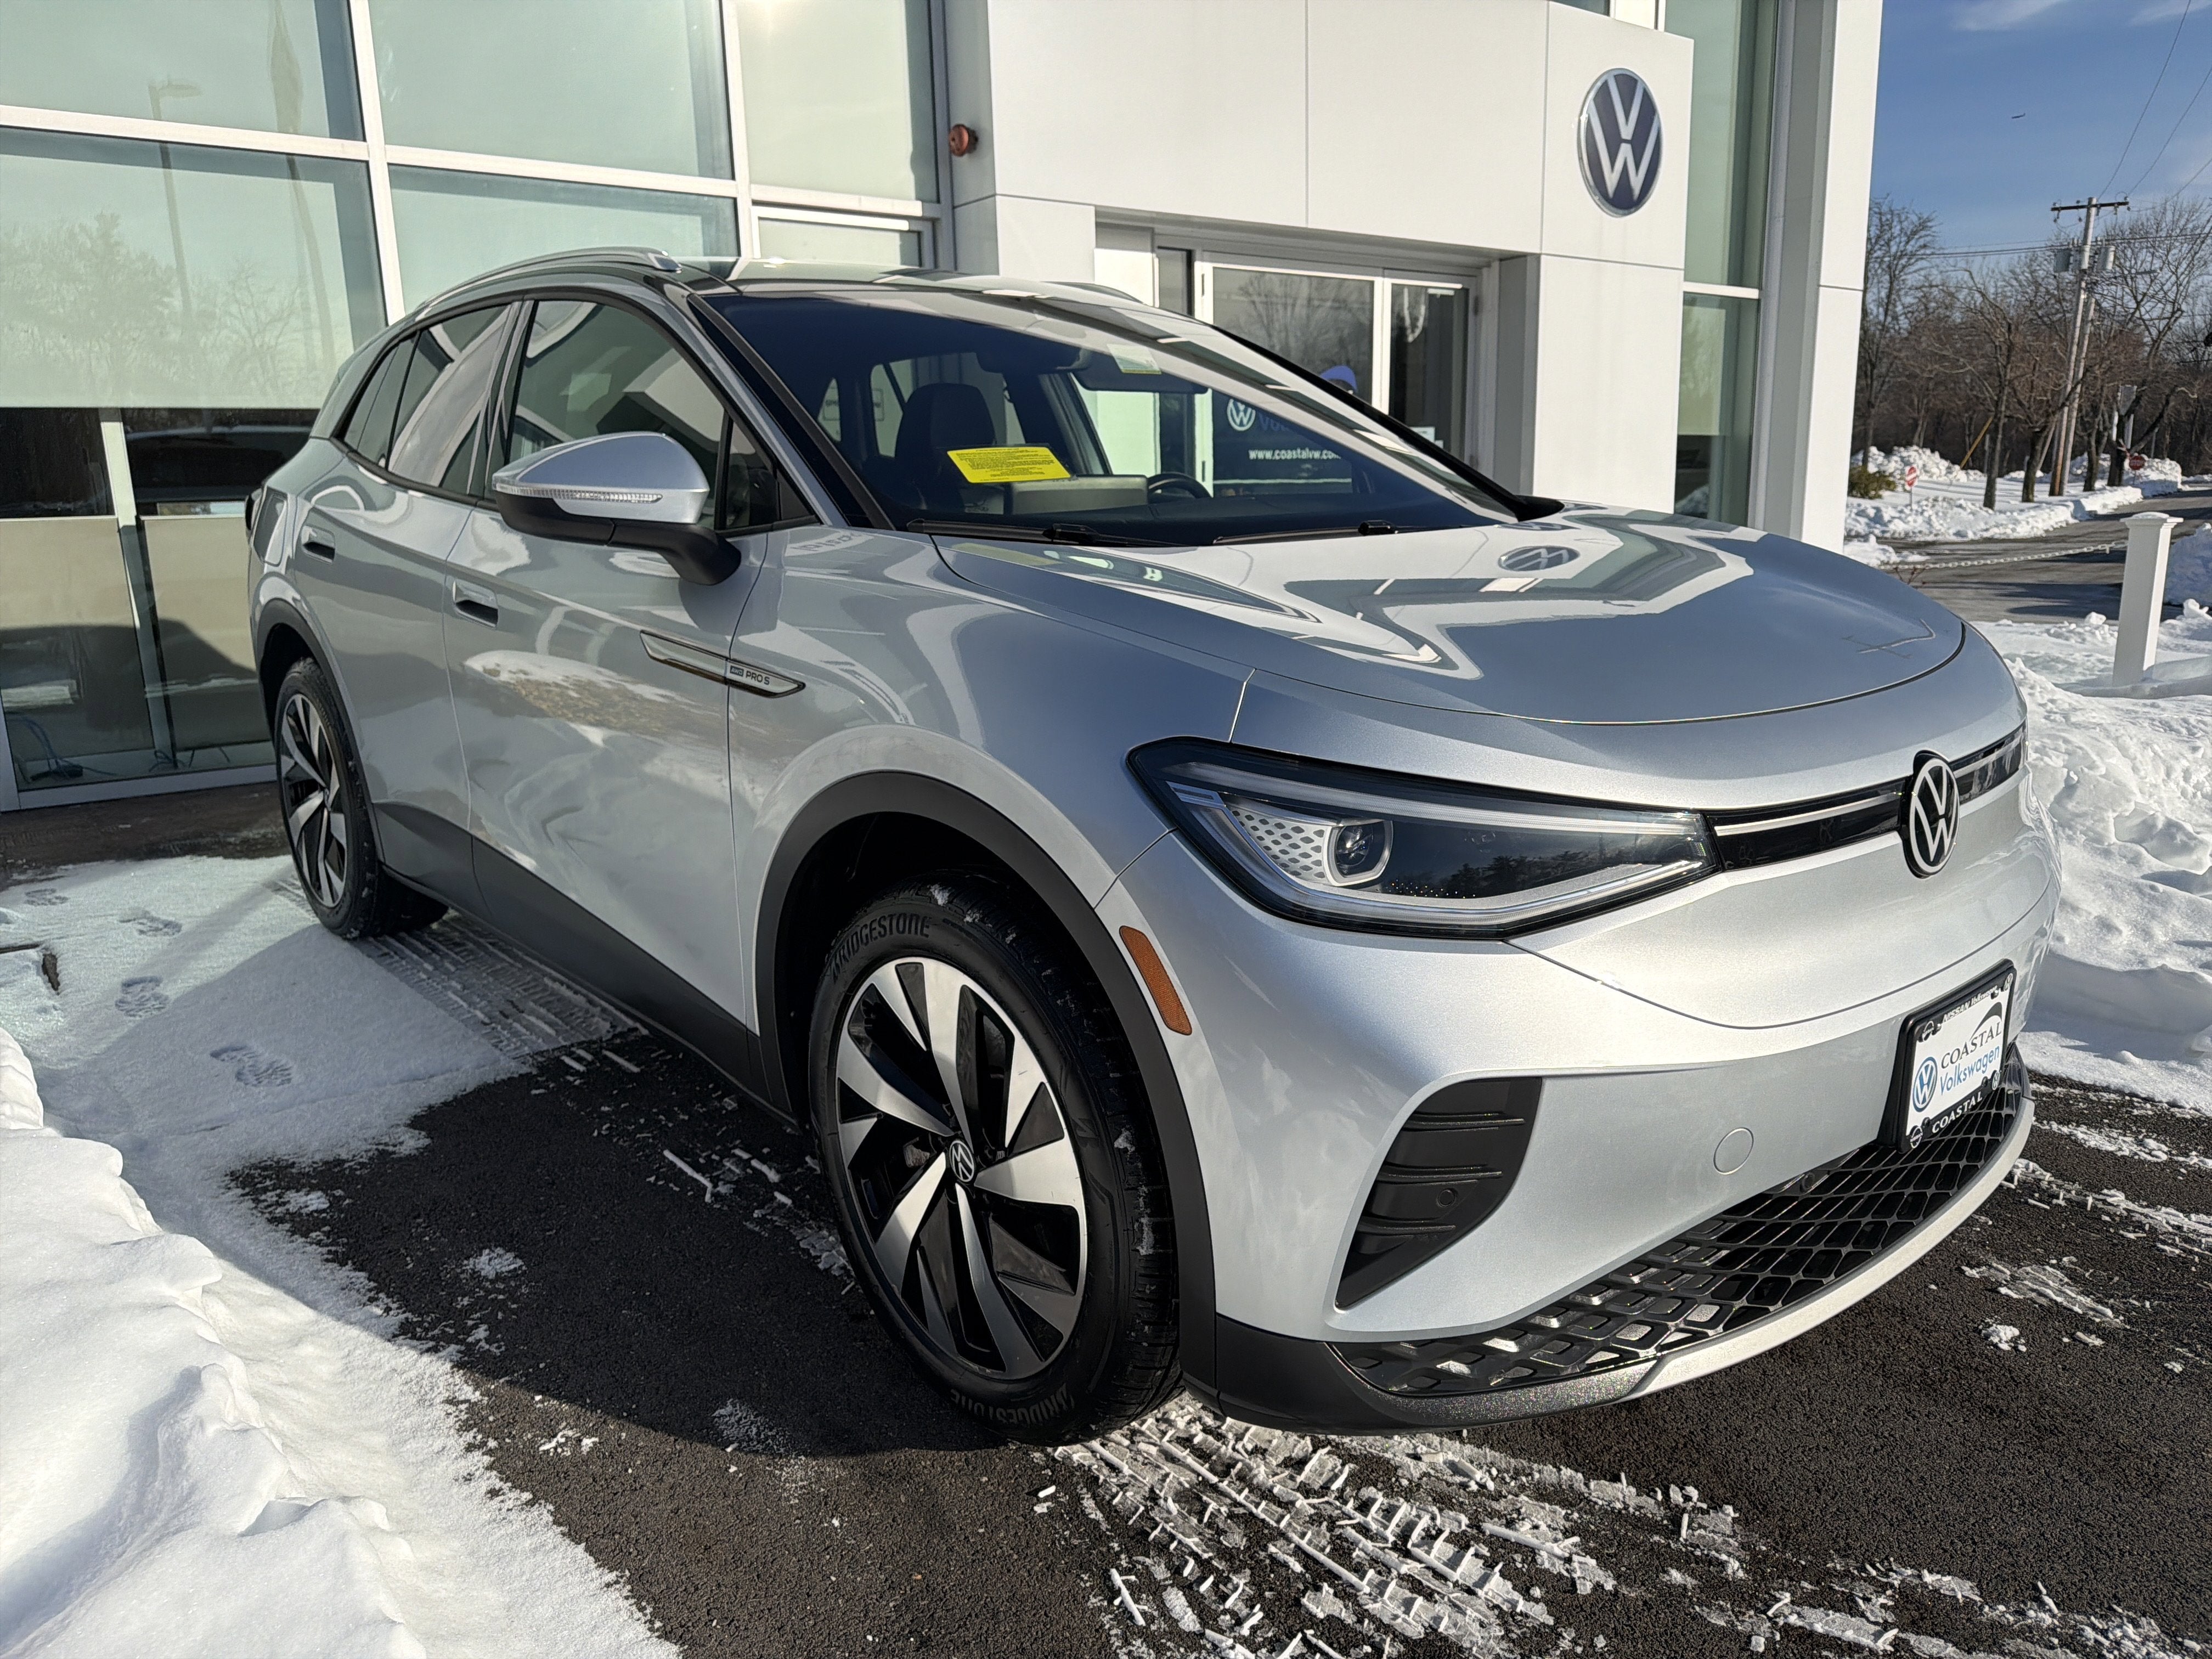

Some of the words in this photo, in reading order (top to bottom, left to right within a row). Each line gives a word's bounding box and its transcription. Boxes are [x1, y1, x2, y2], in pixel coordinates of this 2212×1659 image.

[1580, 69, 1662, 216] VW
[731, 667, 743, 676] AWD
[746, 670, 763, 683] PRO
[764, 676, 770, 685] S
[1910, 758, 1959, 874] VW
[830, 913, 933, 985] BRIDGESTONE
[1941, 1022, 2002, 1069] COASTAL
[1940, 1046, 2000, 1096] Volkswagen
[1932, 1091, 1983, 1133] COASTAL
